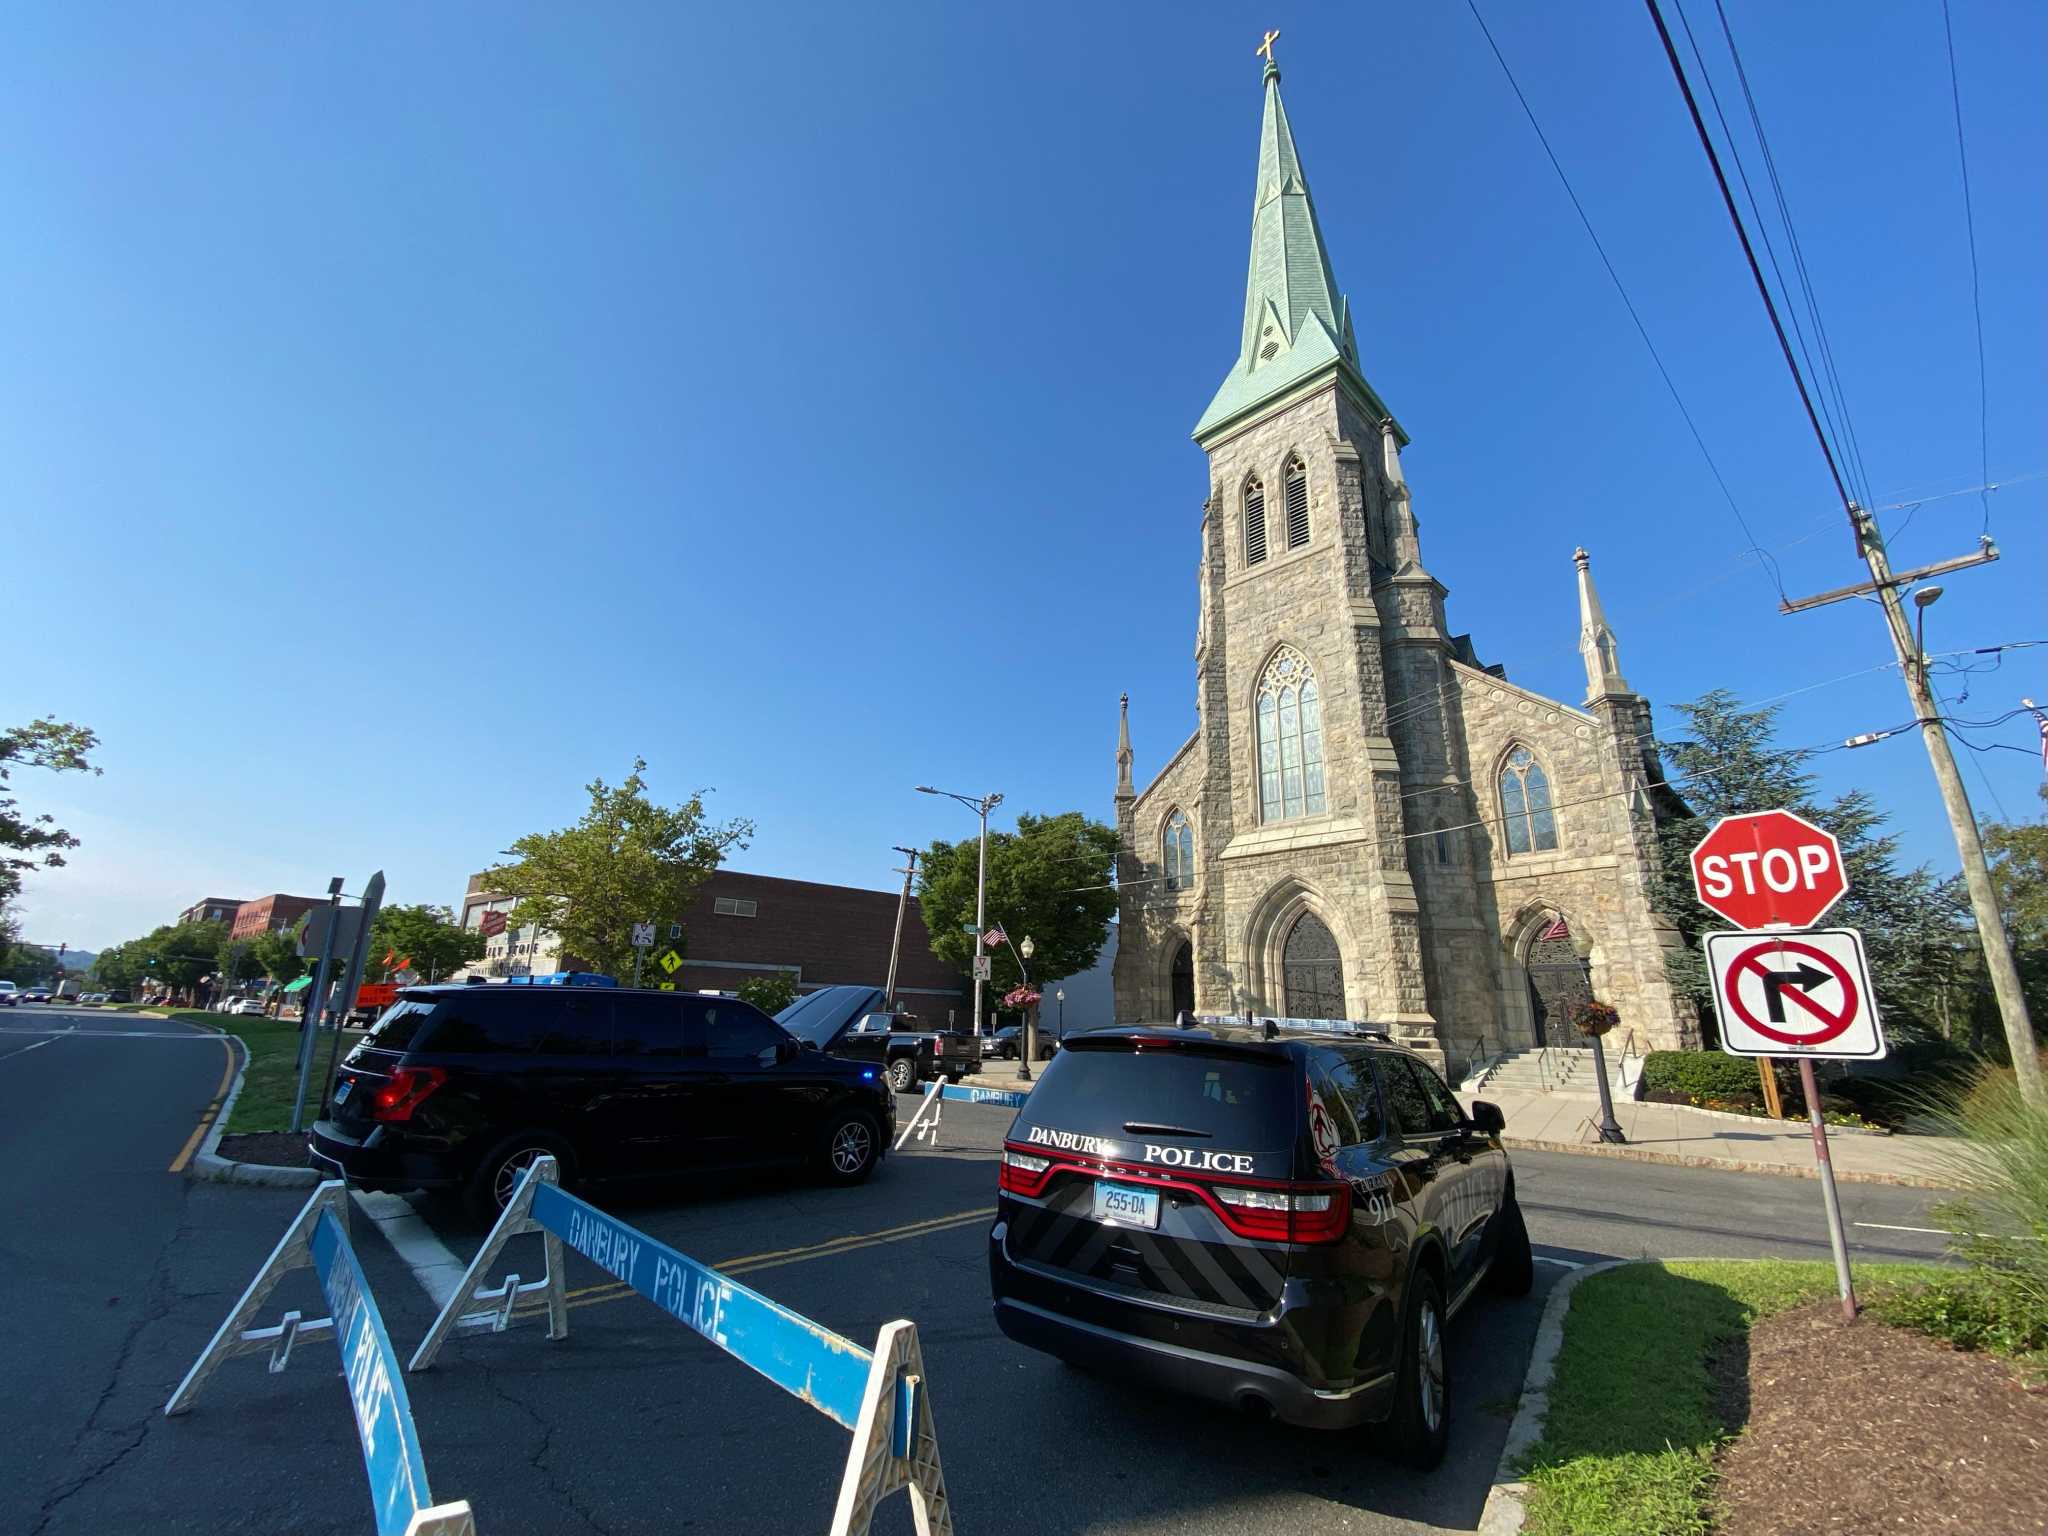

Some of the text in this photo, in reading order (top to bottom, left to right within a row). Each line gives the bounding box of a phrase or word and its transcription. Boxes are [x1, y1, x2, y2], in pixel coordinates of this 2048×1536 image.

[1702, 844, 1830, 898] STOP
[971, 1088, 1021, 1107] DANBURY
[1028, 1127, 1111, 1153] DANBURY
[1144, 1144, 1254, 1174] POLICE
[1369, 1191, 1398, 1226] 911
[1440, 1168, 1489, 1233] POLICE
[569, 1209, 732, 1345] DANBURY POLICE
